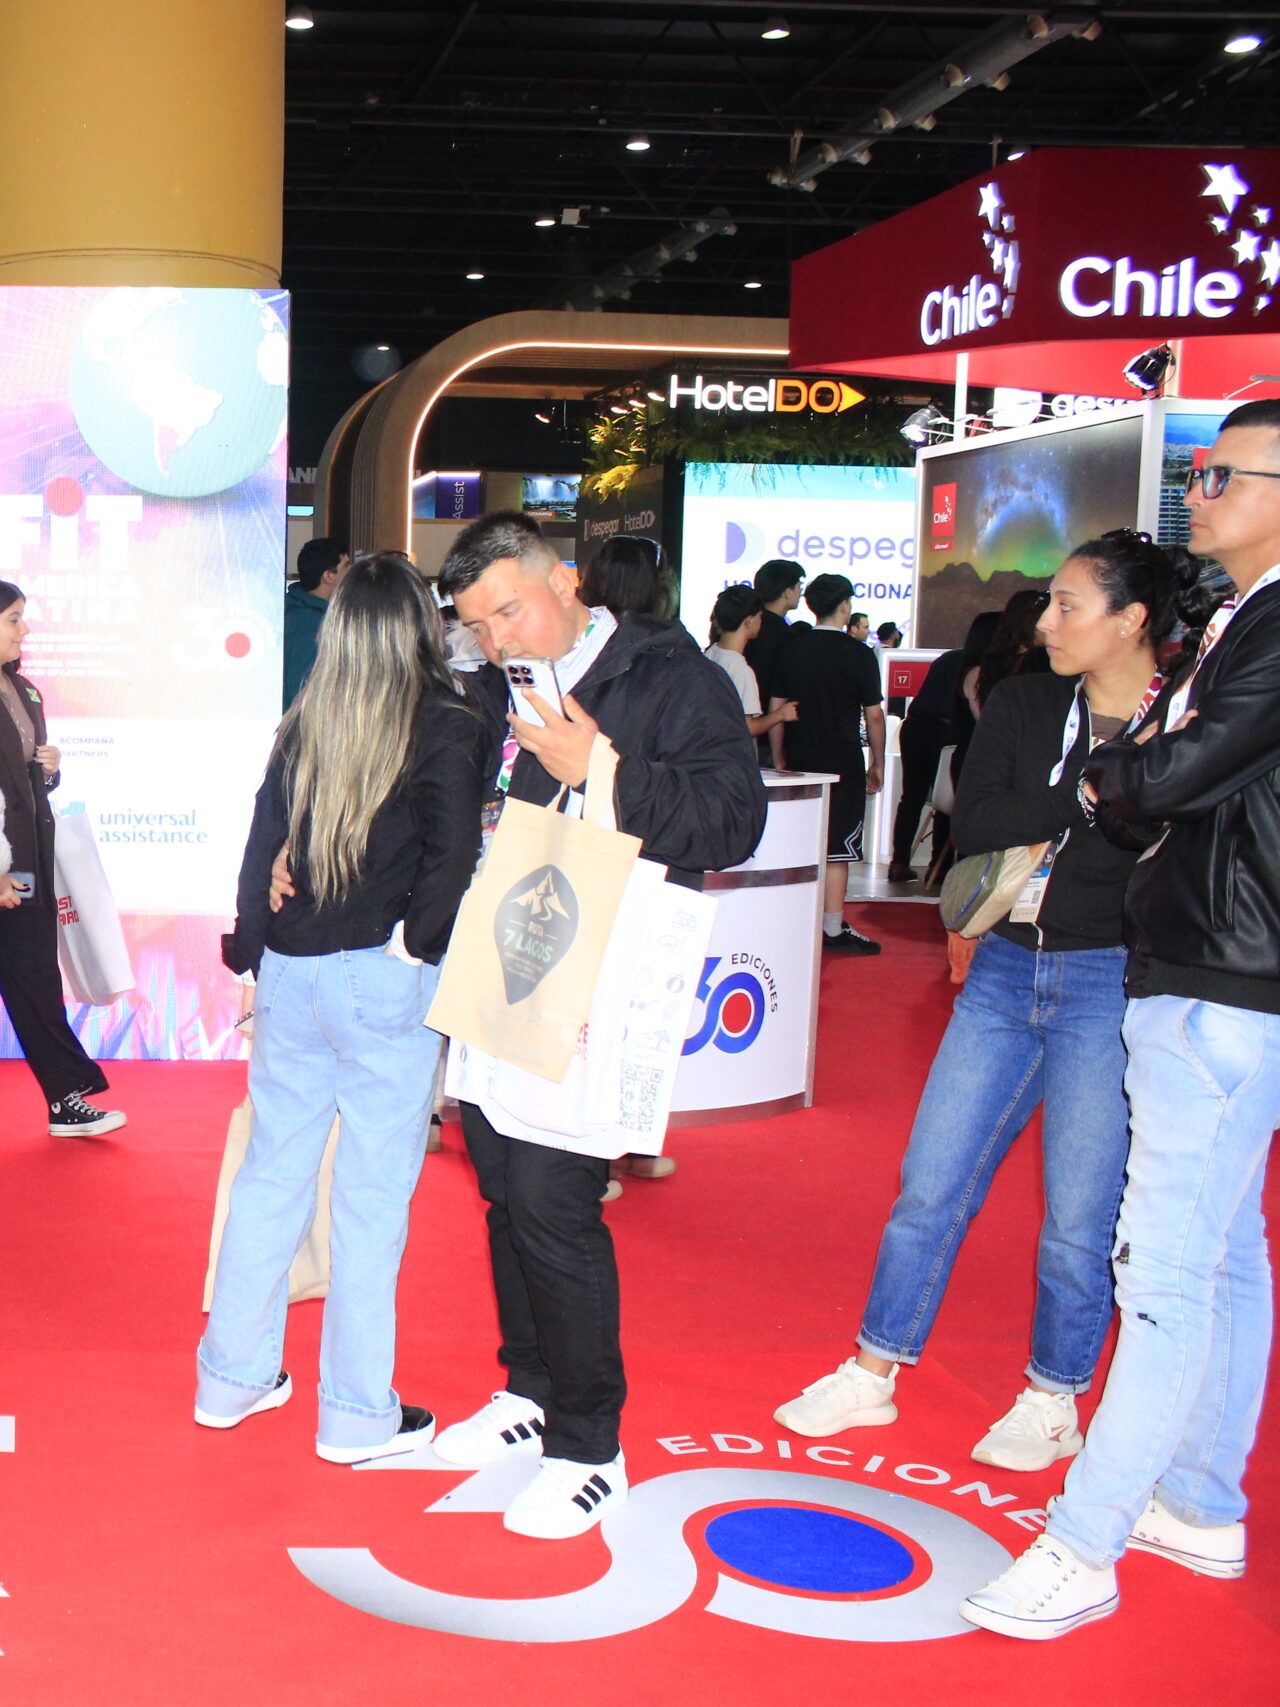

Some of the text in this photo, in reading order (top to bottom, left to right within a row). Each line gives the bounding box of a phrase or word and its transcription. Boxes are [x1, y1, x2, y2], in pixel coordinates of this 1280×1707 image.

[1059, 255, 1242, 318] Chile
[920, 272, 1001, 347] Chile
[670, 374, 841, 413] HotelDO
[2, 573, 144, 598] MERICA
[22, 598, 140, 623] ATINA
[897, 675, 908, 684] 17
[100, 808, 197, 826] universal
[99, 826, 209, 844] assistance
[731, 952, 778, 1013] EDICIONES
[656, 1433, 1048, 1532] EDICIONE
